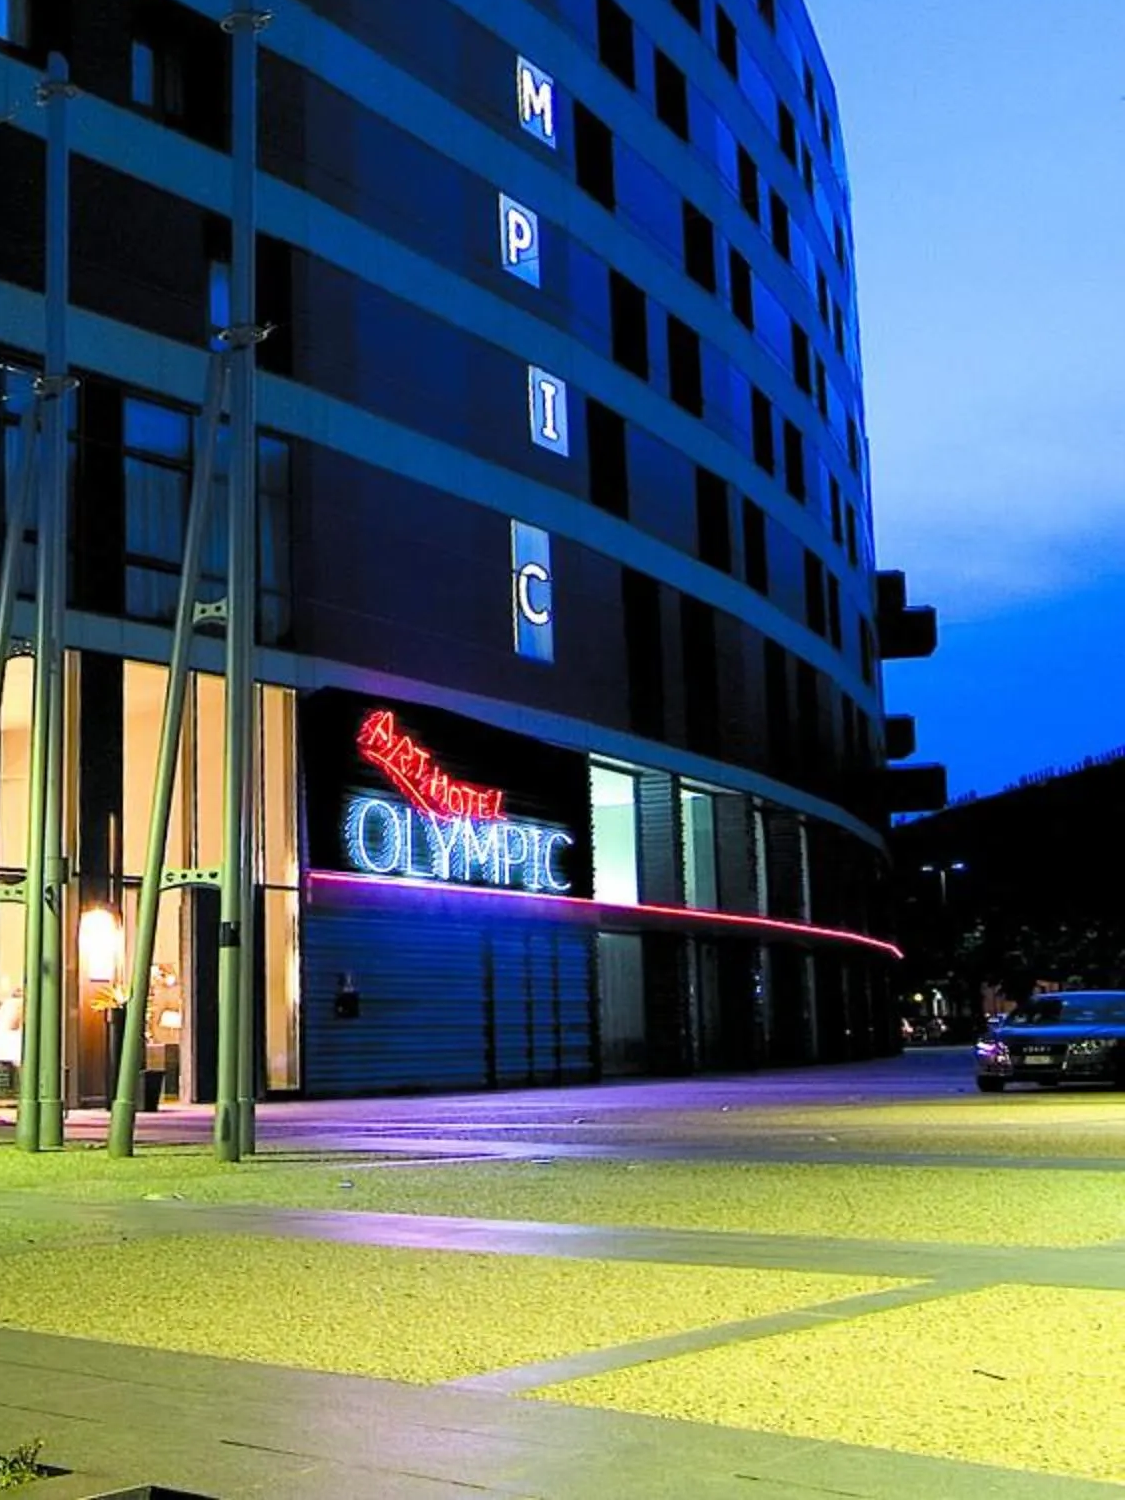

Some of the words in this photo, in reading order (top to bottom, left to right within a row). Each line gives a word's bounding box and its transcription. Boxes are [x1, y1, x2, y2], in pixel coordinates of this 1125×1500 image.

[362, 710, 431, 780] ART
[429, 766, 508, 821] HOTEL
[351, 798, 574, 892] OLYMPIC
